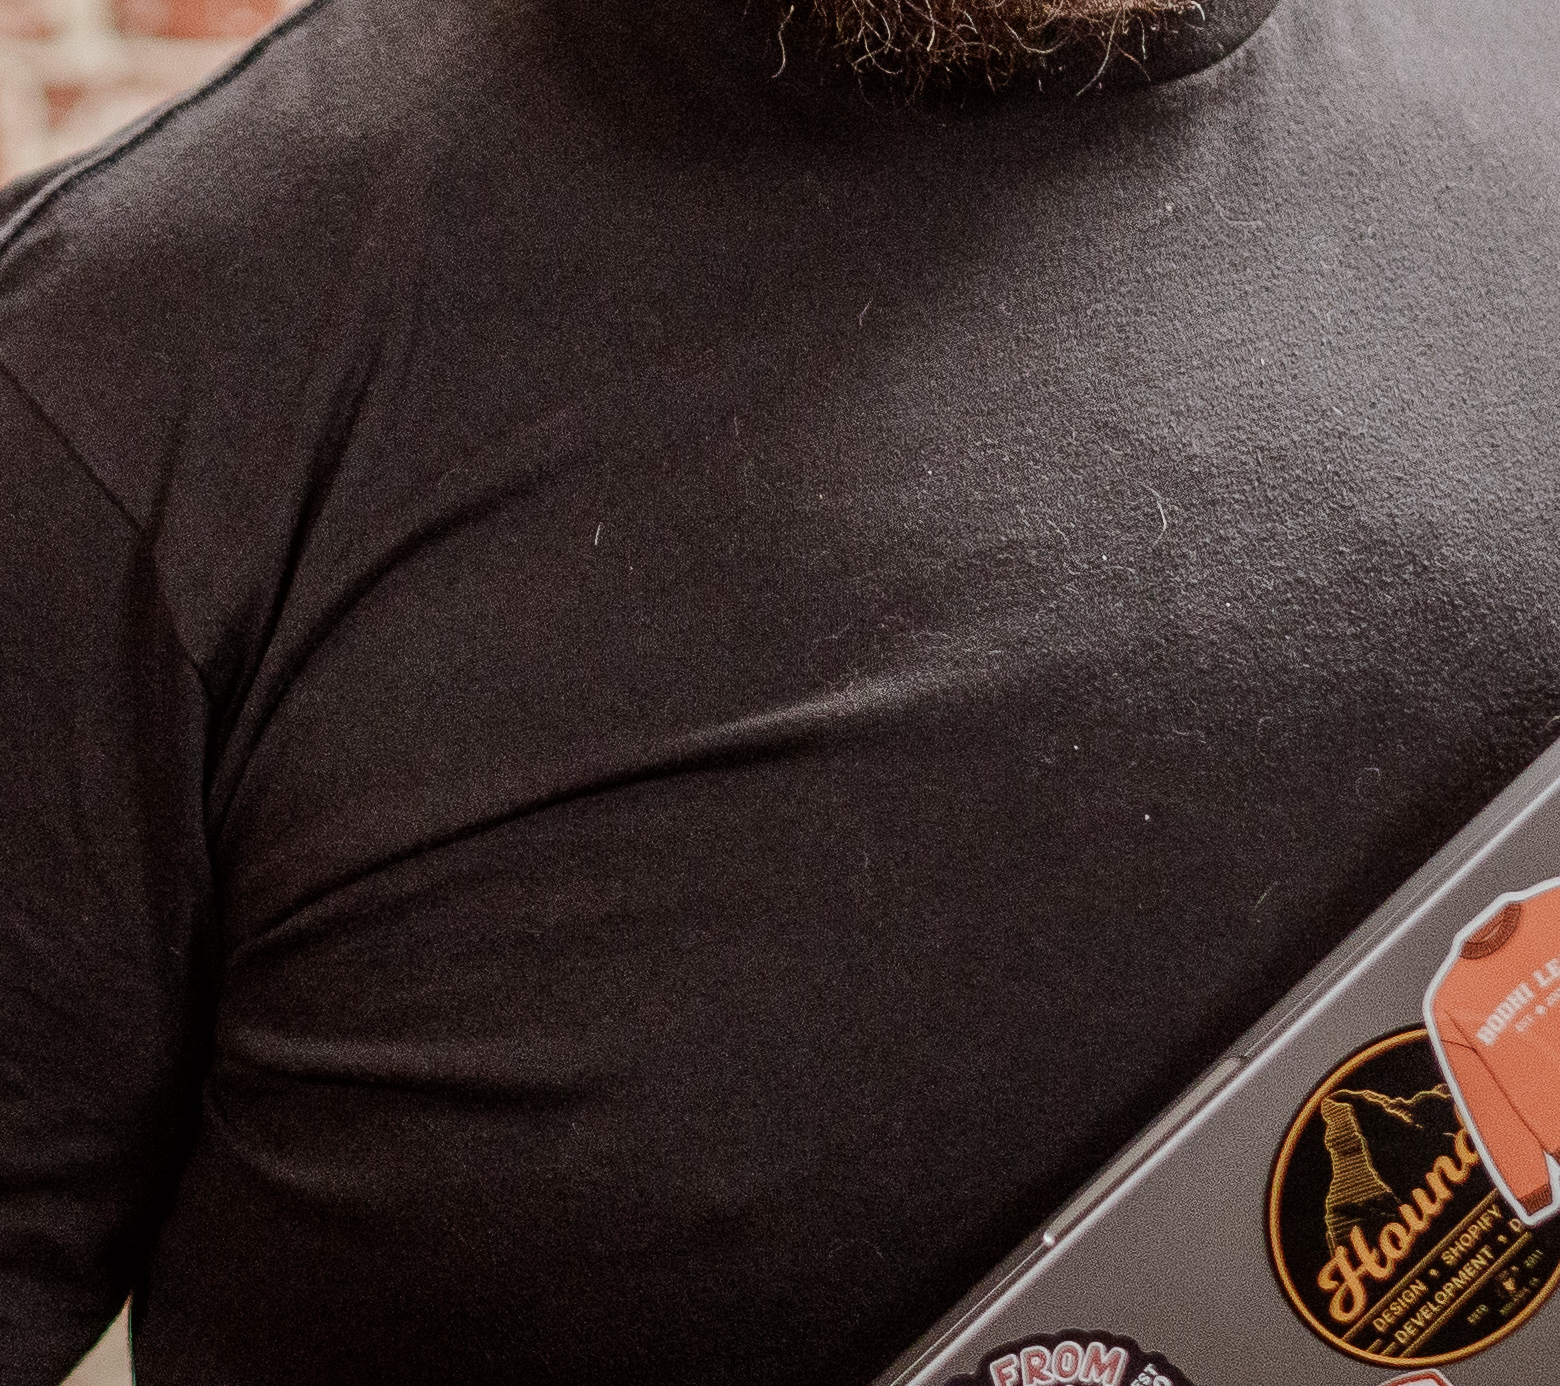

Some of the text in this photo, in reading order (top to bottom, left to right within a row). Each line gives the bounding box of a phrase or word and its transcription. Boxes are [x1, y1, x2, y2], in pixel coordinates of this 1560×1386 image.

[1476, 982, 1535, 1046] BODHI
[1373, 1279, 1430, 1333] DESIGN
[1440, 1203, 1504, 1268] SHOPIFY
[1394, 1246, 1496, 1346] DEVELOPMENT
